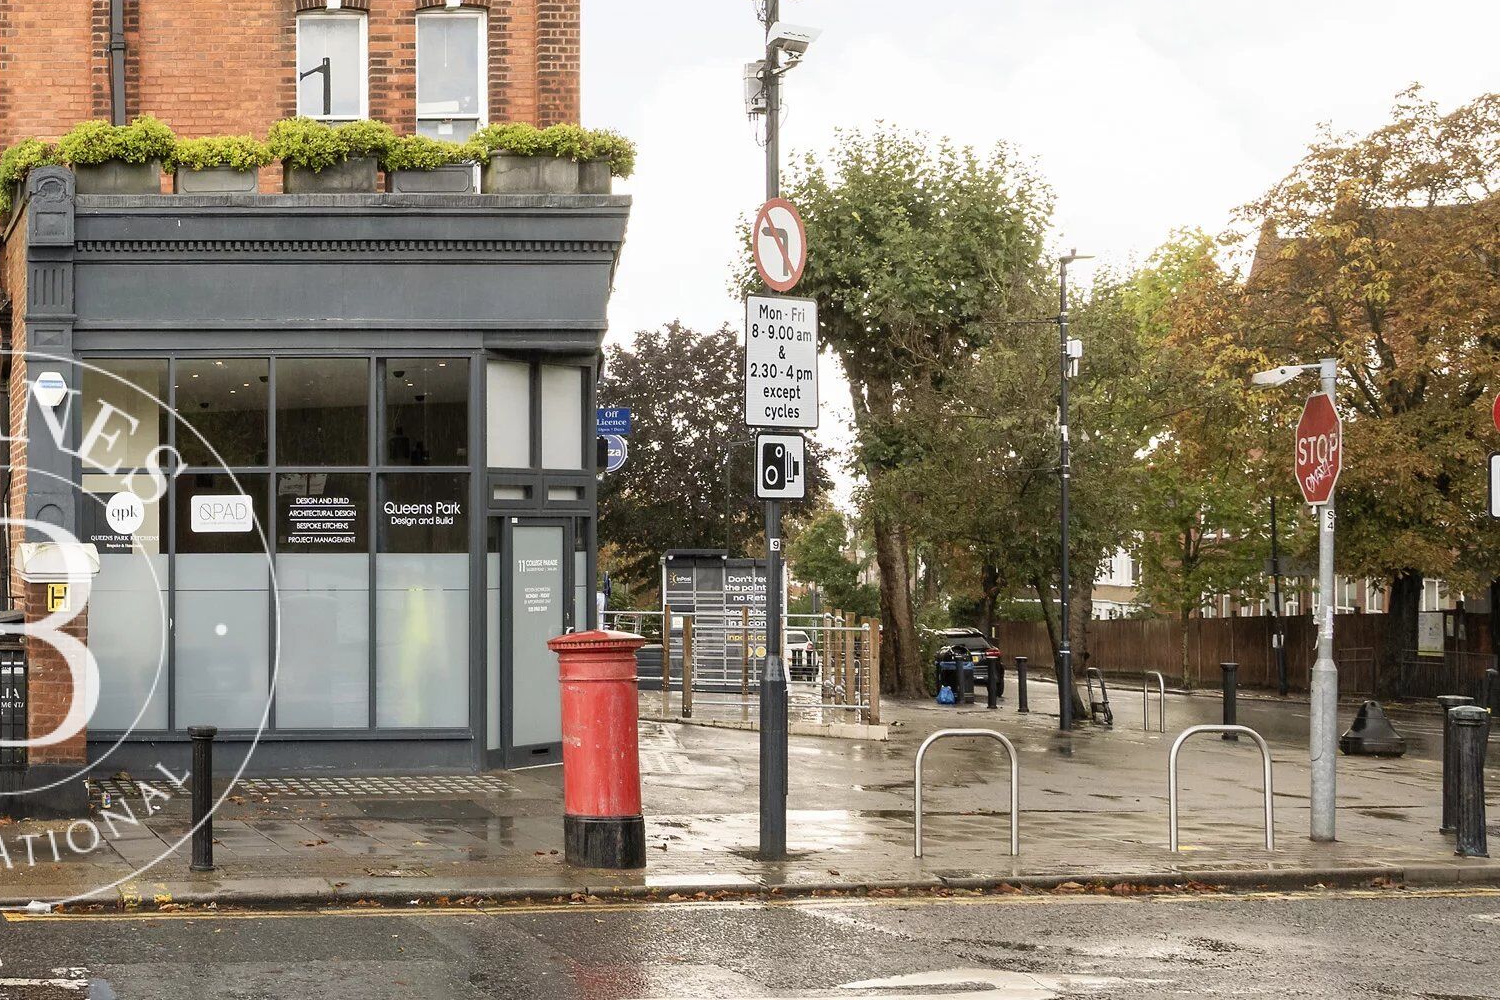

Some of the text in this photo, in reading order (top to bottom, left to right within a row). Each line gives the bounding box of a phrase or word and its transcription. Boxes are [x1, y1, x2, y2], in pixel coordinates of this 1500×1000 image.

[759, 304, 782, 320] Mon
[791, 307, 805, 322] Fri
[752, 323, 759, 338] 8
[768, 325, 794, 340] 9.00
[796, 330, 812, 342] am
[778, 345, 786, 360] &
[750, 362, 777, 378] 2.30
[786, 365, 794, 380] 4
[796, 368, 813, 382] pm
[763, 385, 801, 401] except
[764, 404, 800, 420] cycles
[1298, 433, 1339, 466] STOP
[111, 505, 138, 521] qpk
[288, 509, 356, 517] ARCHITECTURAL DESIGN
[384, 501, 461, 514] Queens Park
[391, 516, 454, 526] Design and Build
[288, 536, 356, 544] PROJECT MANAGEMENT
[772, 540, 780, 549] 9
[518, 560, 526, 572] 11
[728, 575, 752, 583] Don't
[725, 584, 767, 593] the point
[51, 586, 67, 609] H
